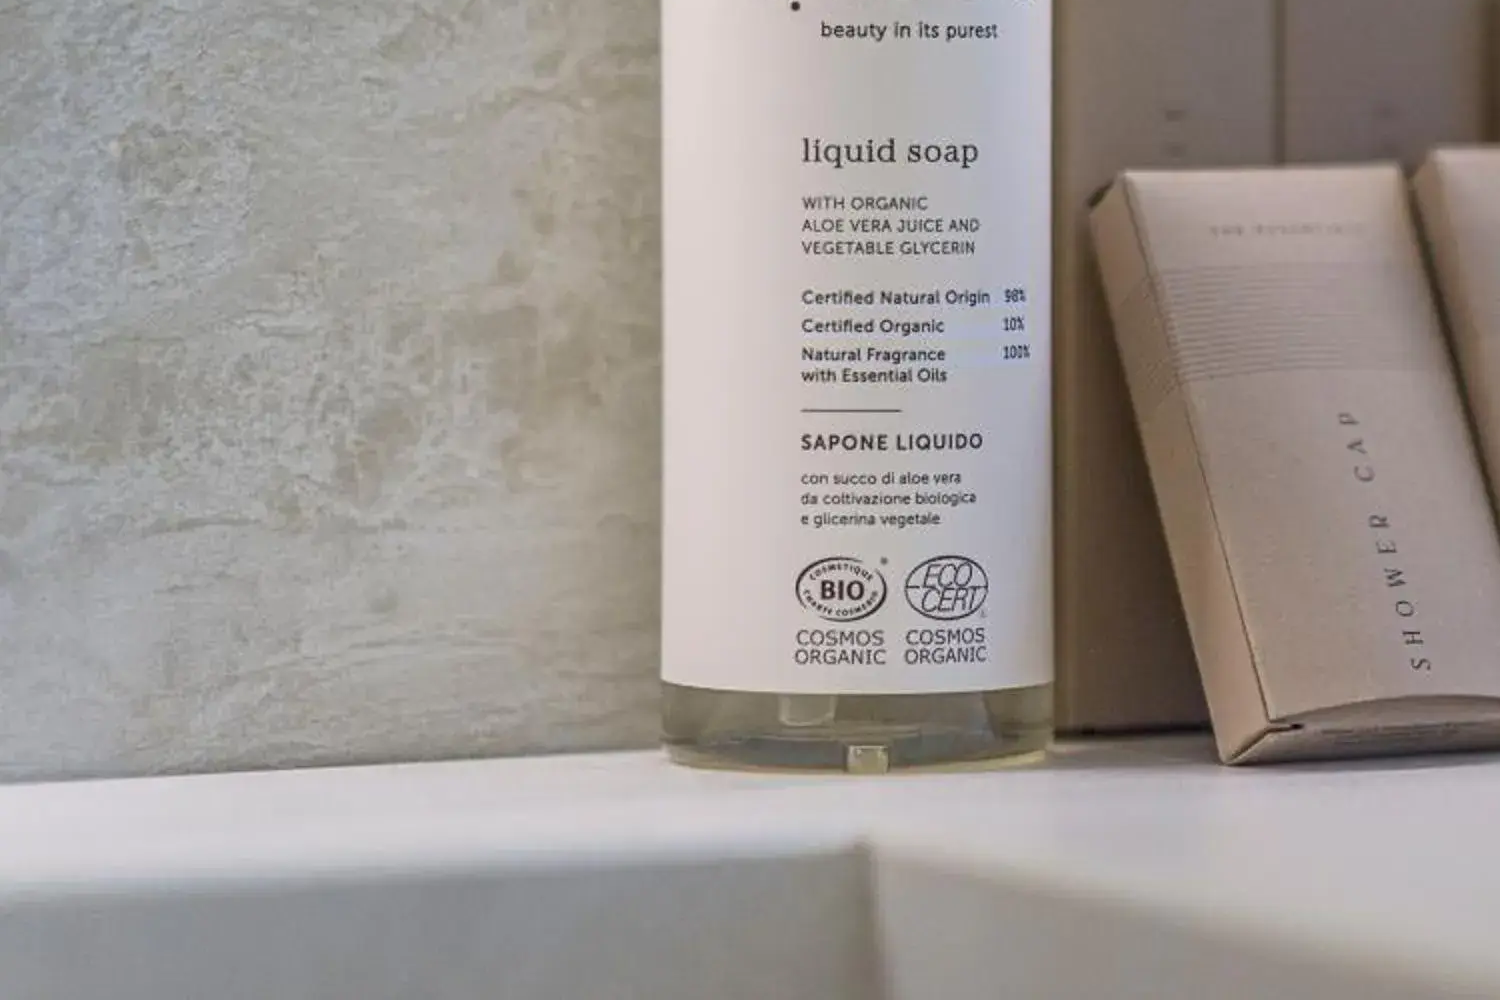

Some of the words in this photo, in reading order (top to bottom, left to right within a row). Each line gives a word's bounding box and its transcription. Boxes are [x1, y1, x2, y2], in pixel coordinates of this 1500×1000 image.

[820, 20, 887, 43] beauty
[893, 20, 912, 39] in
[918, 20, 940, 39] its
[945, 23, 999, 43] purest
[801, 137, 896, 169] liquid
[905, 142, 979, 169] soap
[801, 197, 845, 211] WITH
[850, 196, 929, 211] ORGANIC
[801, 218, 845, 233] ALOE
[849, 218, 892, 233] VERA
[897, 218, 945, 233] JUICE
[947, 218, 981, 233] AND
[800, 240, 895, 255] VEGETABLE
[899, 240, 976, 255] GLYCERIN
[800, 289, 875, 306] Certified
[879, 289, 941, 305] Natural
[945, 289, 991, 307] Origin
[800, 317, 875, 334] Certified
[879, 317, 945, 337] Organic
[801, 346, 862, 362] Natural
[866, 346, 946, 365] Fragrance
[801, 366, 837, 382] with
[841, 366, 913, 383] Essential
[917, 366, 948, 383] Oils
[800, 433, 889, 451] SAPONE
[896, 432, 984, 451] LIQUIDO
[1337, 412, 1376, 483] CAP
[800, 474, 829, 486] con
[833, 474, 878, 486] succo
[881, 471, 896, 486] di
[899, 471, 930, 485] aloe
[933, 473, 962, 485] vera
[800, 491, 818, 506] da
[822, 491, 912, 506] coltivazione
[915, 491, 977, 508] biologica
[800, 514, 809, 526] e
[813, 511, 876, 529] glicerina
[879, 511, 942, 528] vegetale
[923, 562, 974, 589] ECO
[821, 580, 865, 600] BIO
[1368, 514, 1432, 672] SHOWER
[795, 629, 886, 647] COSMOS
[905, 627, 986, 646] COSMOS
[794, 648, 887, 666] ORGANIC
[904, 646, 988, 665] ORGANIC
